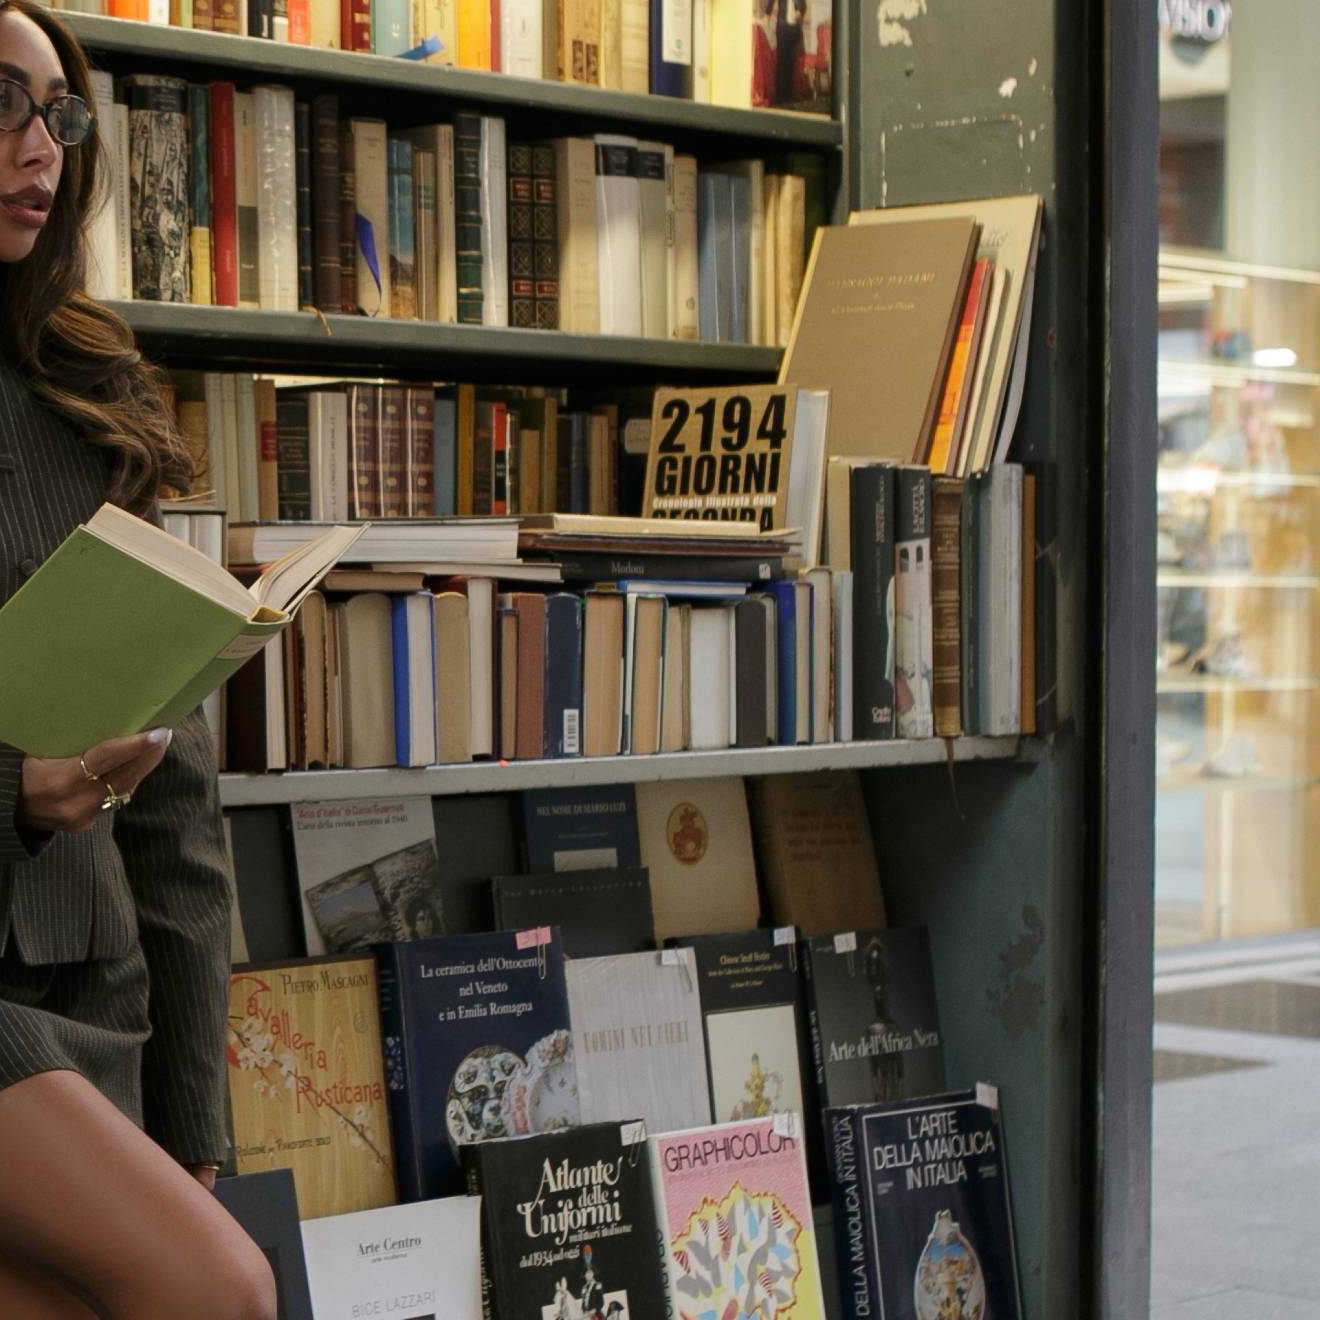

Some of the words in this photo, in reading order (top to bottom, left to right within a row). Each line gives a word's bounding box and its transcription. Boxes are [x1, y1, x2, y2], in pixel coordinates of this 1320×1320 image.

[658, 394, 787, 454] 2194
[654, 451, 781, 498] GIORNI
[653, 497, 703, 510] Cronologia
[706, 495, 750, 508] illustrata
[753, 494, 777, 506] della
[421, 965, 434, 979] La
[436, 961, 475, 978] ceramica
[477, 955, 543, 975] dell'Ottocento
[459, 983, 473, 997] nel
[475, 980, 509, 996] Veneto
[446, 1008, 456, 1020] in
[458, 1005, 487, 1019] Emilia
[490, 1001, 533, 1019] Romagna
[829, 1041, 856, 1063] Arte
[857, 1030, 913, 1058] dell'Africa
[914, 1029, 939, 1049] Nera
[295, 1065, 382, 1114] Rusticana
[838, 1115, 856, 1163] ITALIA
[907, 1111, 959, 1140] L'ARTE
[663, 1131, 796, 1174] GRAPHICOLOR
[873, 1144, 923, 1171] DELLA
[925, 1130, 996, 1163] MAIOLICA
[535, 1155, 623, 1198] Atlante
[841, 1165, 857, 1182] IN
[905, 1167, 922, 1191] IN
[923, 1160, 968, 1188] ITALIA
[578, 1185, 609, 1209] delle
[516, 1190, 622, 1245] Uniformi
[845, 1185, 865, 1262] MAIOLICA
[357, 1242, 380, 1257] Arte
[383, 1237, 421, 1251] Centro
[532, 1250, 553, 1268] 1934
[352, 1300, 381, 1318] BICE
[386, 1291, 436, 1313] LAZZARI
[851, 1265, 871, 1316] DELLA
